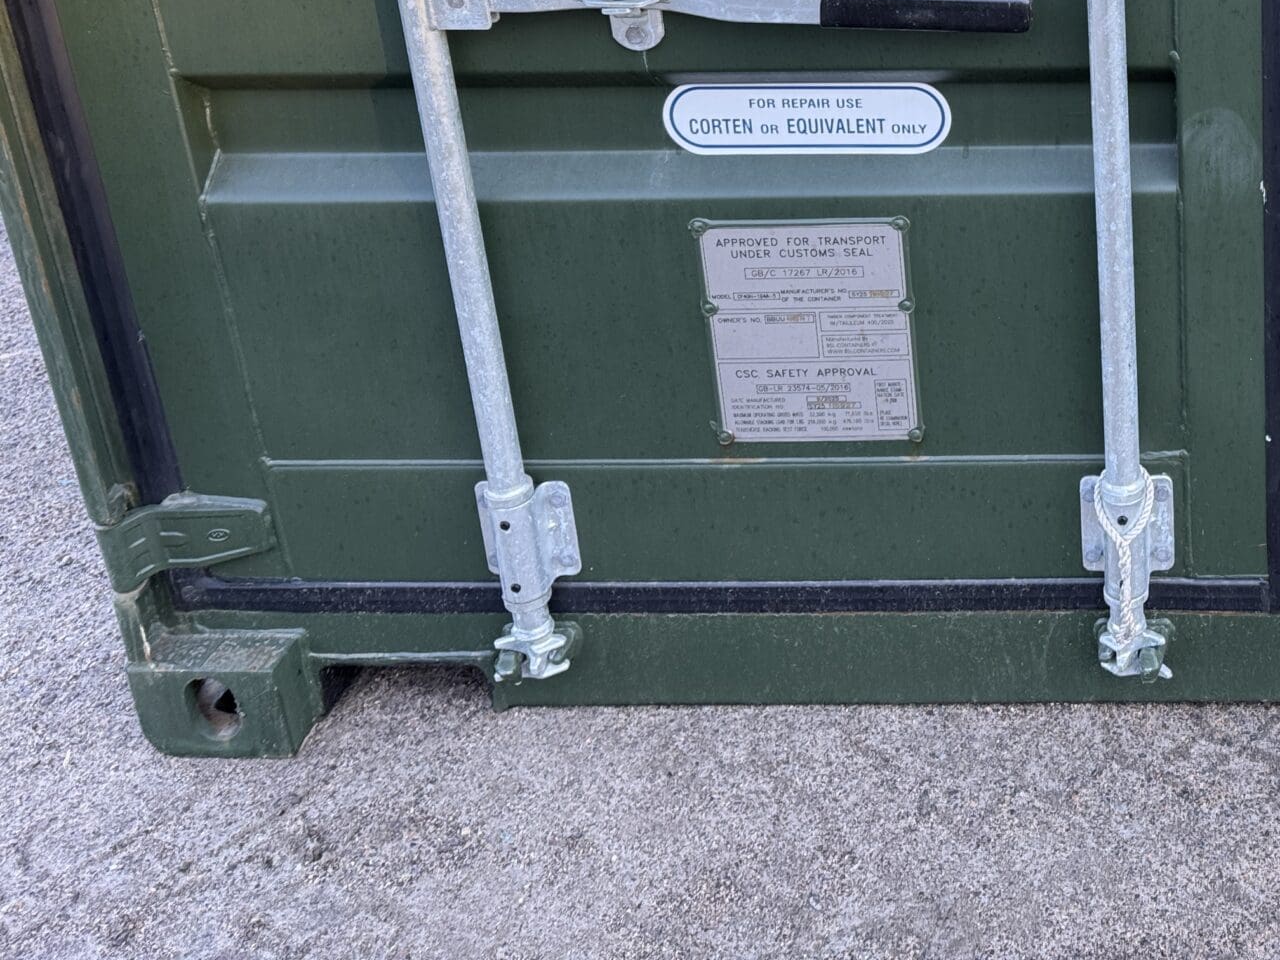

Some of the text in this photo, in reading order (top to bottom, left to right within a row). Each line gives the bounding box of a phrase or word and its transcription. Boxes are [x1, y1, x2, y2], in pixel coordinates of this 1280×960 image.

[749, 98, 863, 109] FOR REPAIR USE
[689, 118, 927, 136] CORTEN OR EQUIVALENT ONLY
[716, 235, 886, 248] APPROVED FOR TRANSPORT
[731, 247, 873, 259] UNDER CUSTOMS SEAL
[751, 269, 775, 279] GB/C
[735, 368, 877, 379] CSC SAFETY APPROVAL
